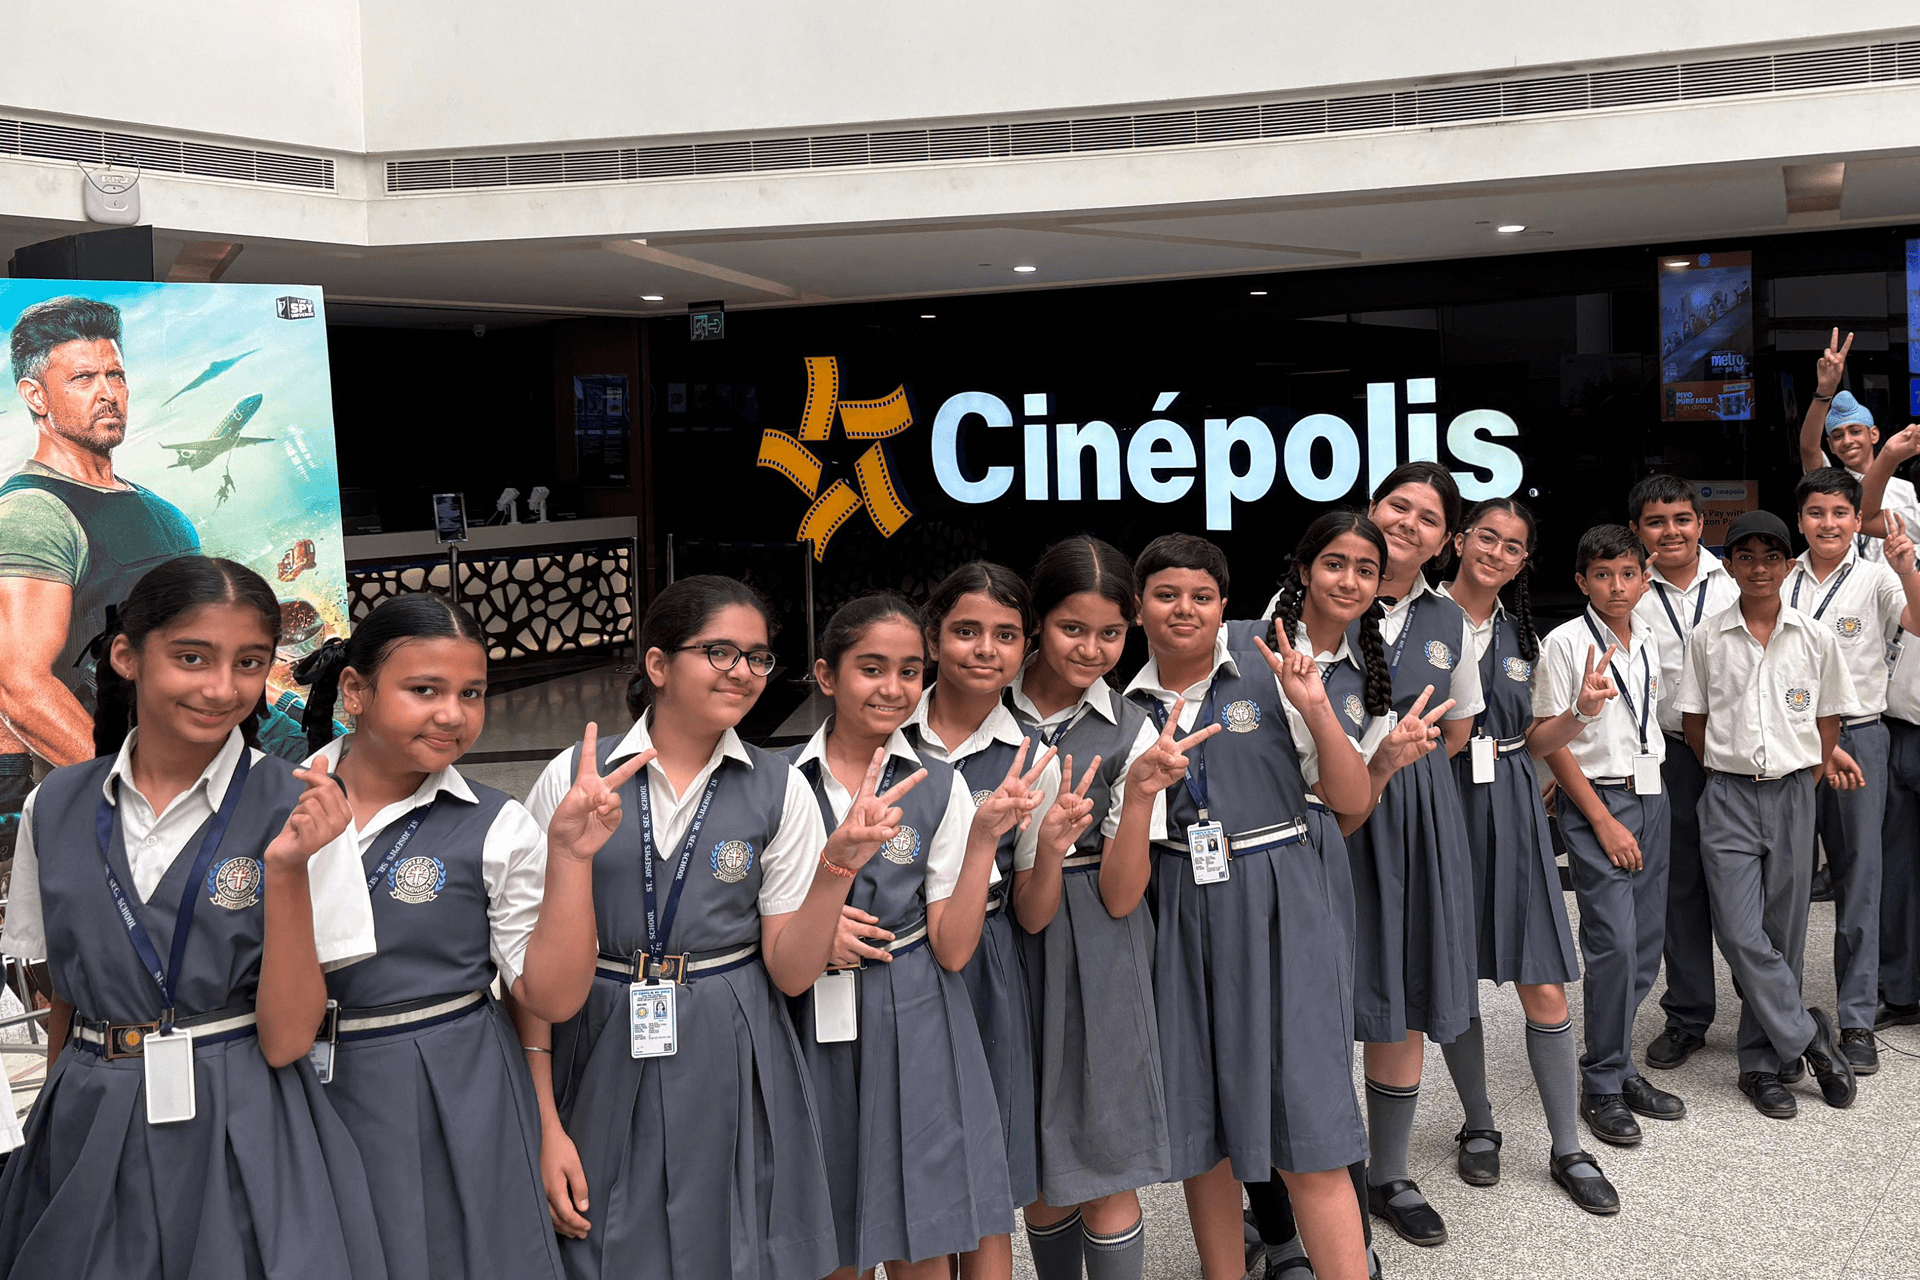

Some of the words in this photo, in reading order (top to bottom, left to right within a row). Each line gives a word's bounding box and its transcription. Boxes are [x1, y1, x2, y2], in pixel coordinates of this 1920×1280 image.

[290, 302, 313, 313] SPY
[931, 377, 1523, 531] Cinépolis
[1709, 509, 1725, 518] Pay
[708, 778, 718, 788] ST.
[639, 783, 649, 811] SCHOOL
[408, 819, 420, 830] ST.
[642, 812, 650, 829] SEC.
[692, 820, 702, 833] SR.
[643, 829, 651, 843] SR.
[685, 834, 697, 850] SEC.
[375, 861, 389, 875] SR.
[675, 851, 691, 881] SCHOOL
[645, 880, 653, 893] ST.
[108, 878, 121, 899] SEC.
[116, 897, 137, 932] SCHOOL
[647, 909, 656, 940] SCHOOL
[154, 970, 165, 986] ST.
